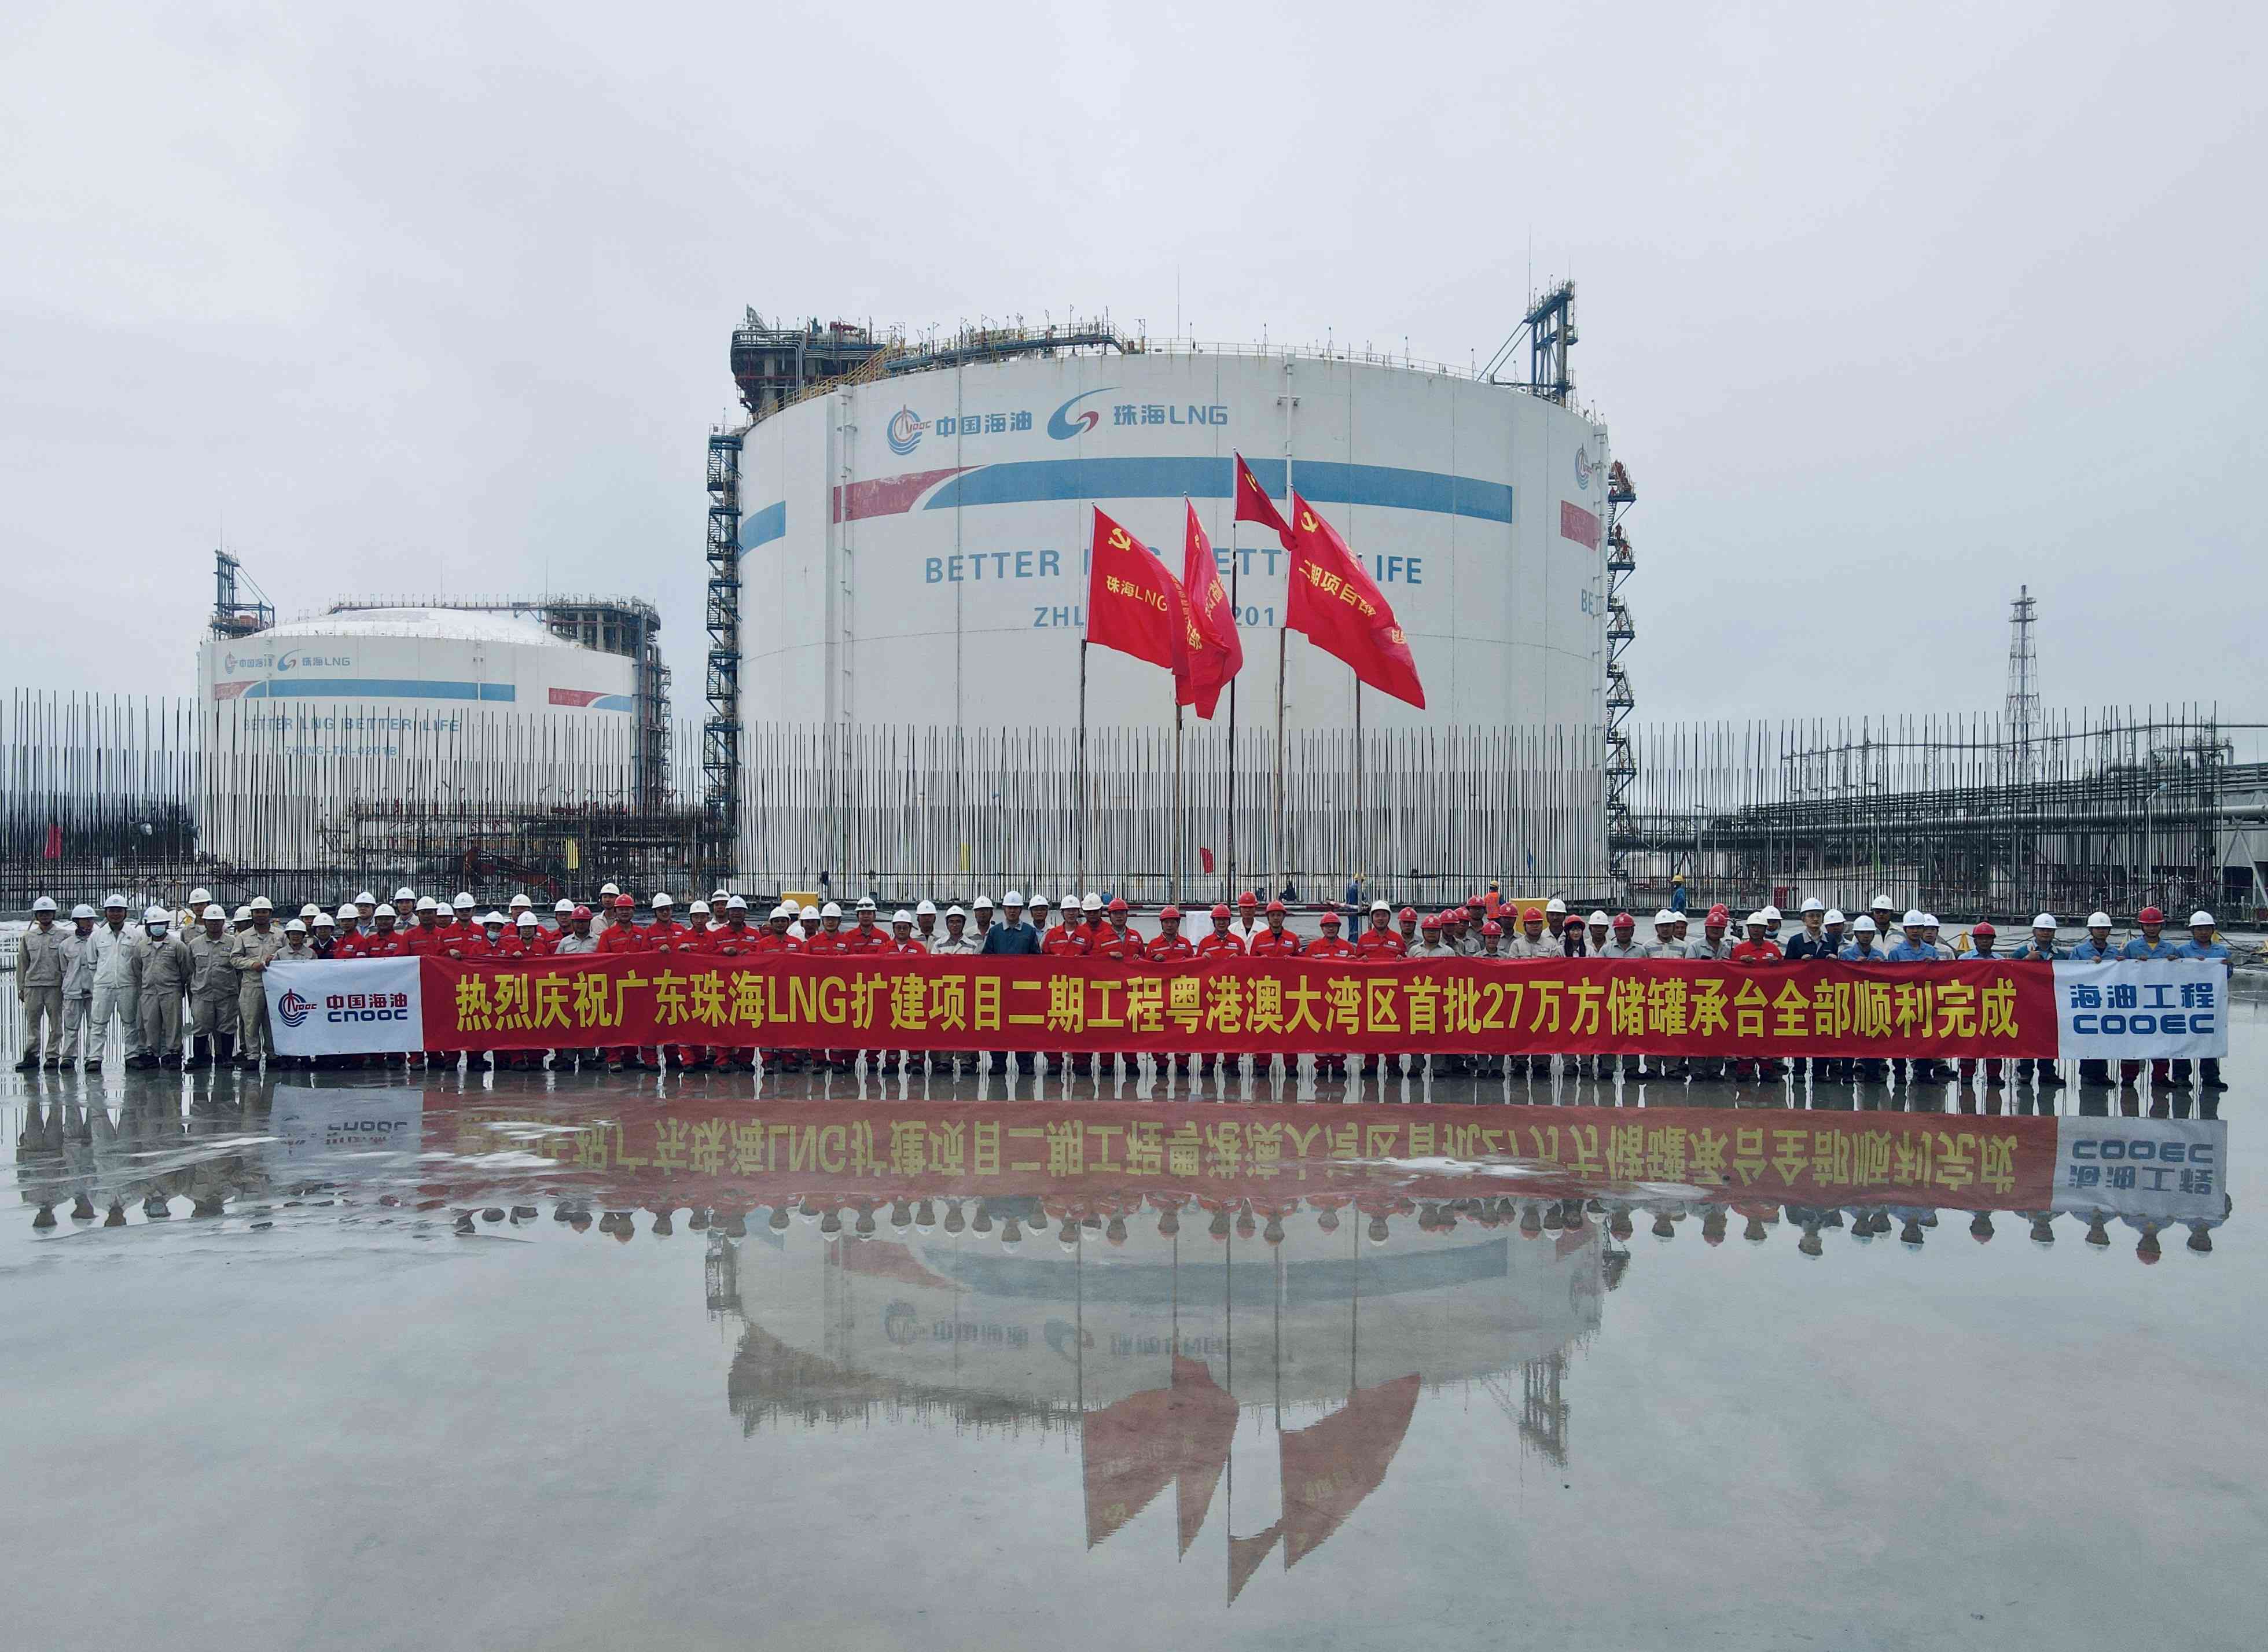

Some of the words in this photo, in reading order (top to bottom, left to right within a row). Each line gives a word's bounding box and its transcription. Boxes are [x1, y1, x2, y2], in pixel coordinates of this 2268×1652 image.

[935, 410, 1032, 437] 中国海油
[1113, 404, 1227, 426] 珠海LNG
[925, 550, 1060, 583] BETTER
[1376, 554, 1422, 584] IFE
[1034, 606, 1085, 627] ZHL
[302, 718, 334, 730] LNG
[344, 718, 411, 731] BETTER
[423, 719, 459, 732] LIFE
[327, 992, 407, 1010] 中国海油
[456, 970, 2019, 1038] 热烈庆祝广东珠海LNG扩建项目二期工程粤港澳大湾区首批27万方储罐承台全部顺利完成
[2071, 983, 2214, 1009] 海油工程
[2073, 1014, 2215, 1034] COOEC
